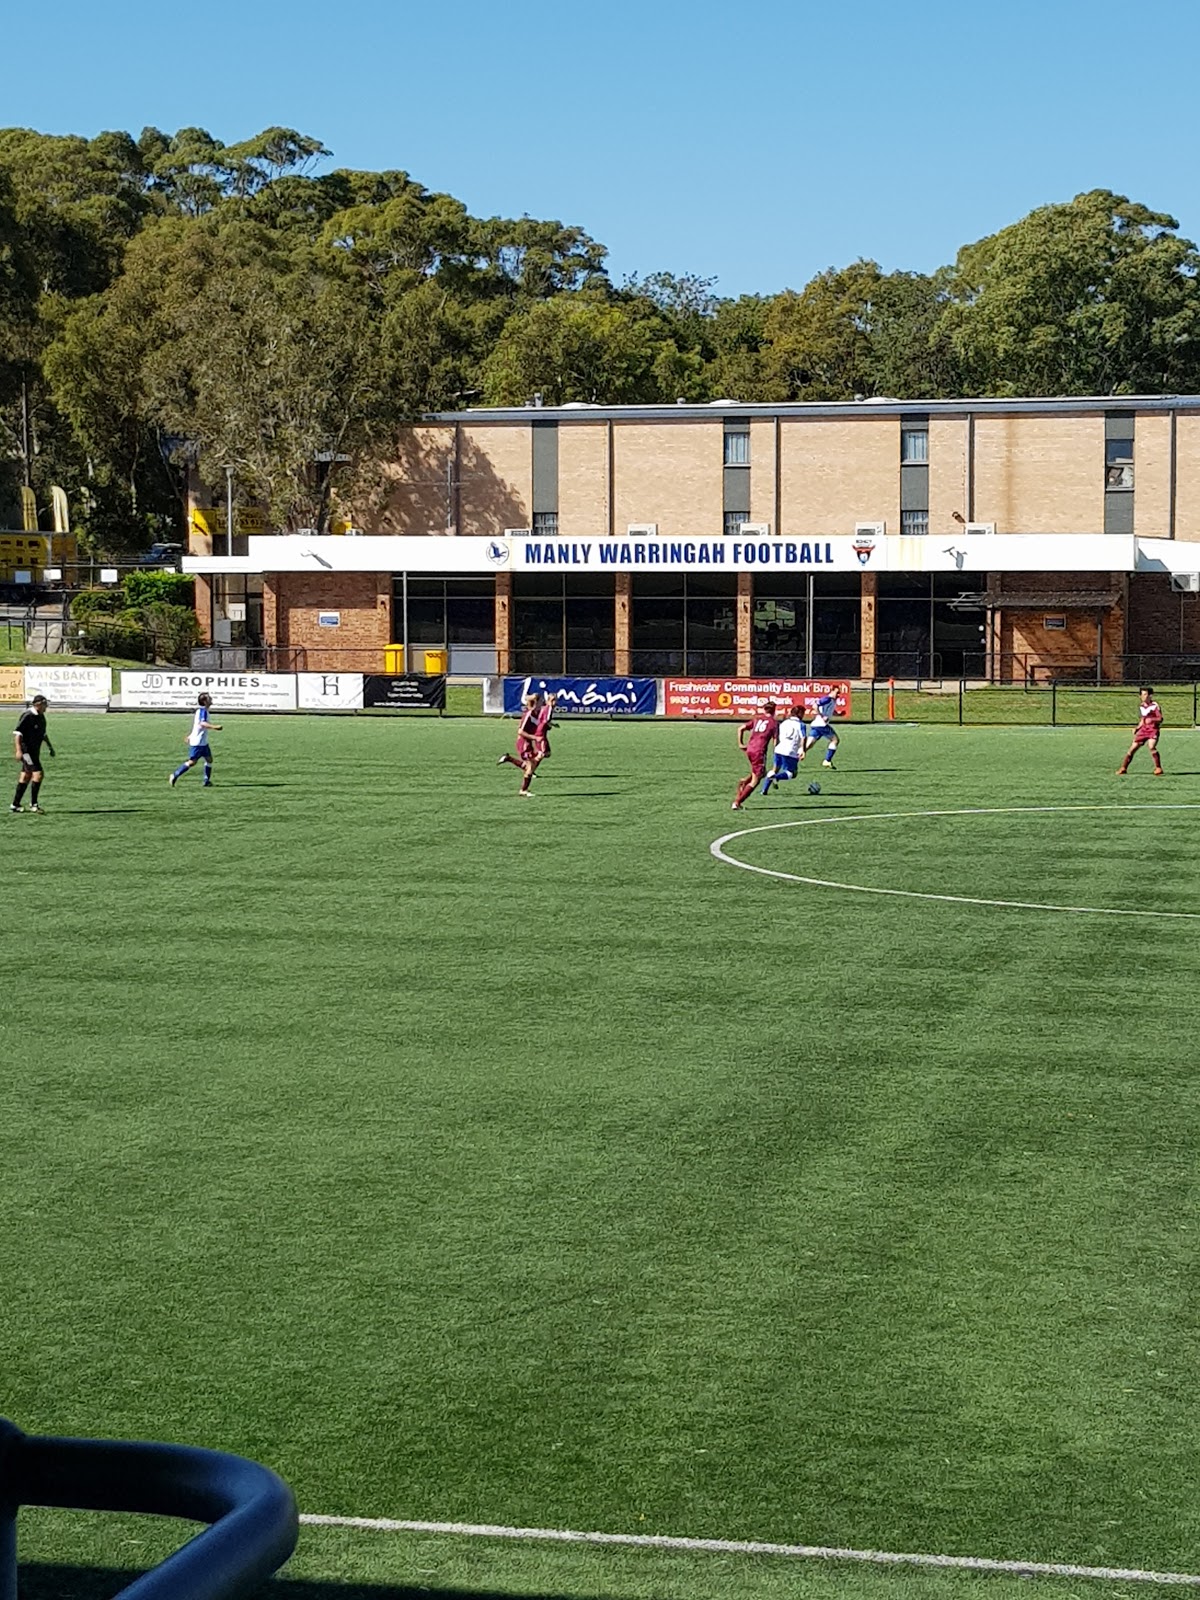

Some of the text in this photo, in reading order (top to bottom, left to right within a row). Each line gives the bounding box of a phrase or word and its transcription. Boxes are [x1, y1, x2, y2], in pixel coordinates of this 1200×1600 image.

[525, 543, 834, 564] MANLY WARRINGAH FOOTBALL
[28, 671, 60, 680] VANS
[142, 674, 260, 688] JD TROPHIES
[669, 682, 848, 694] Freshwater Community Bank Brah
[732, 695, 793, 706] Bendigo Bank
[755, 720, 769, 732] 16
